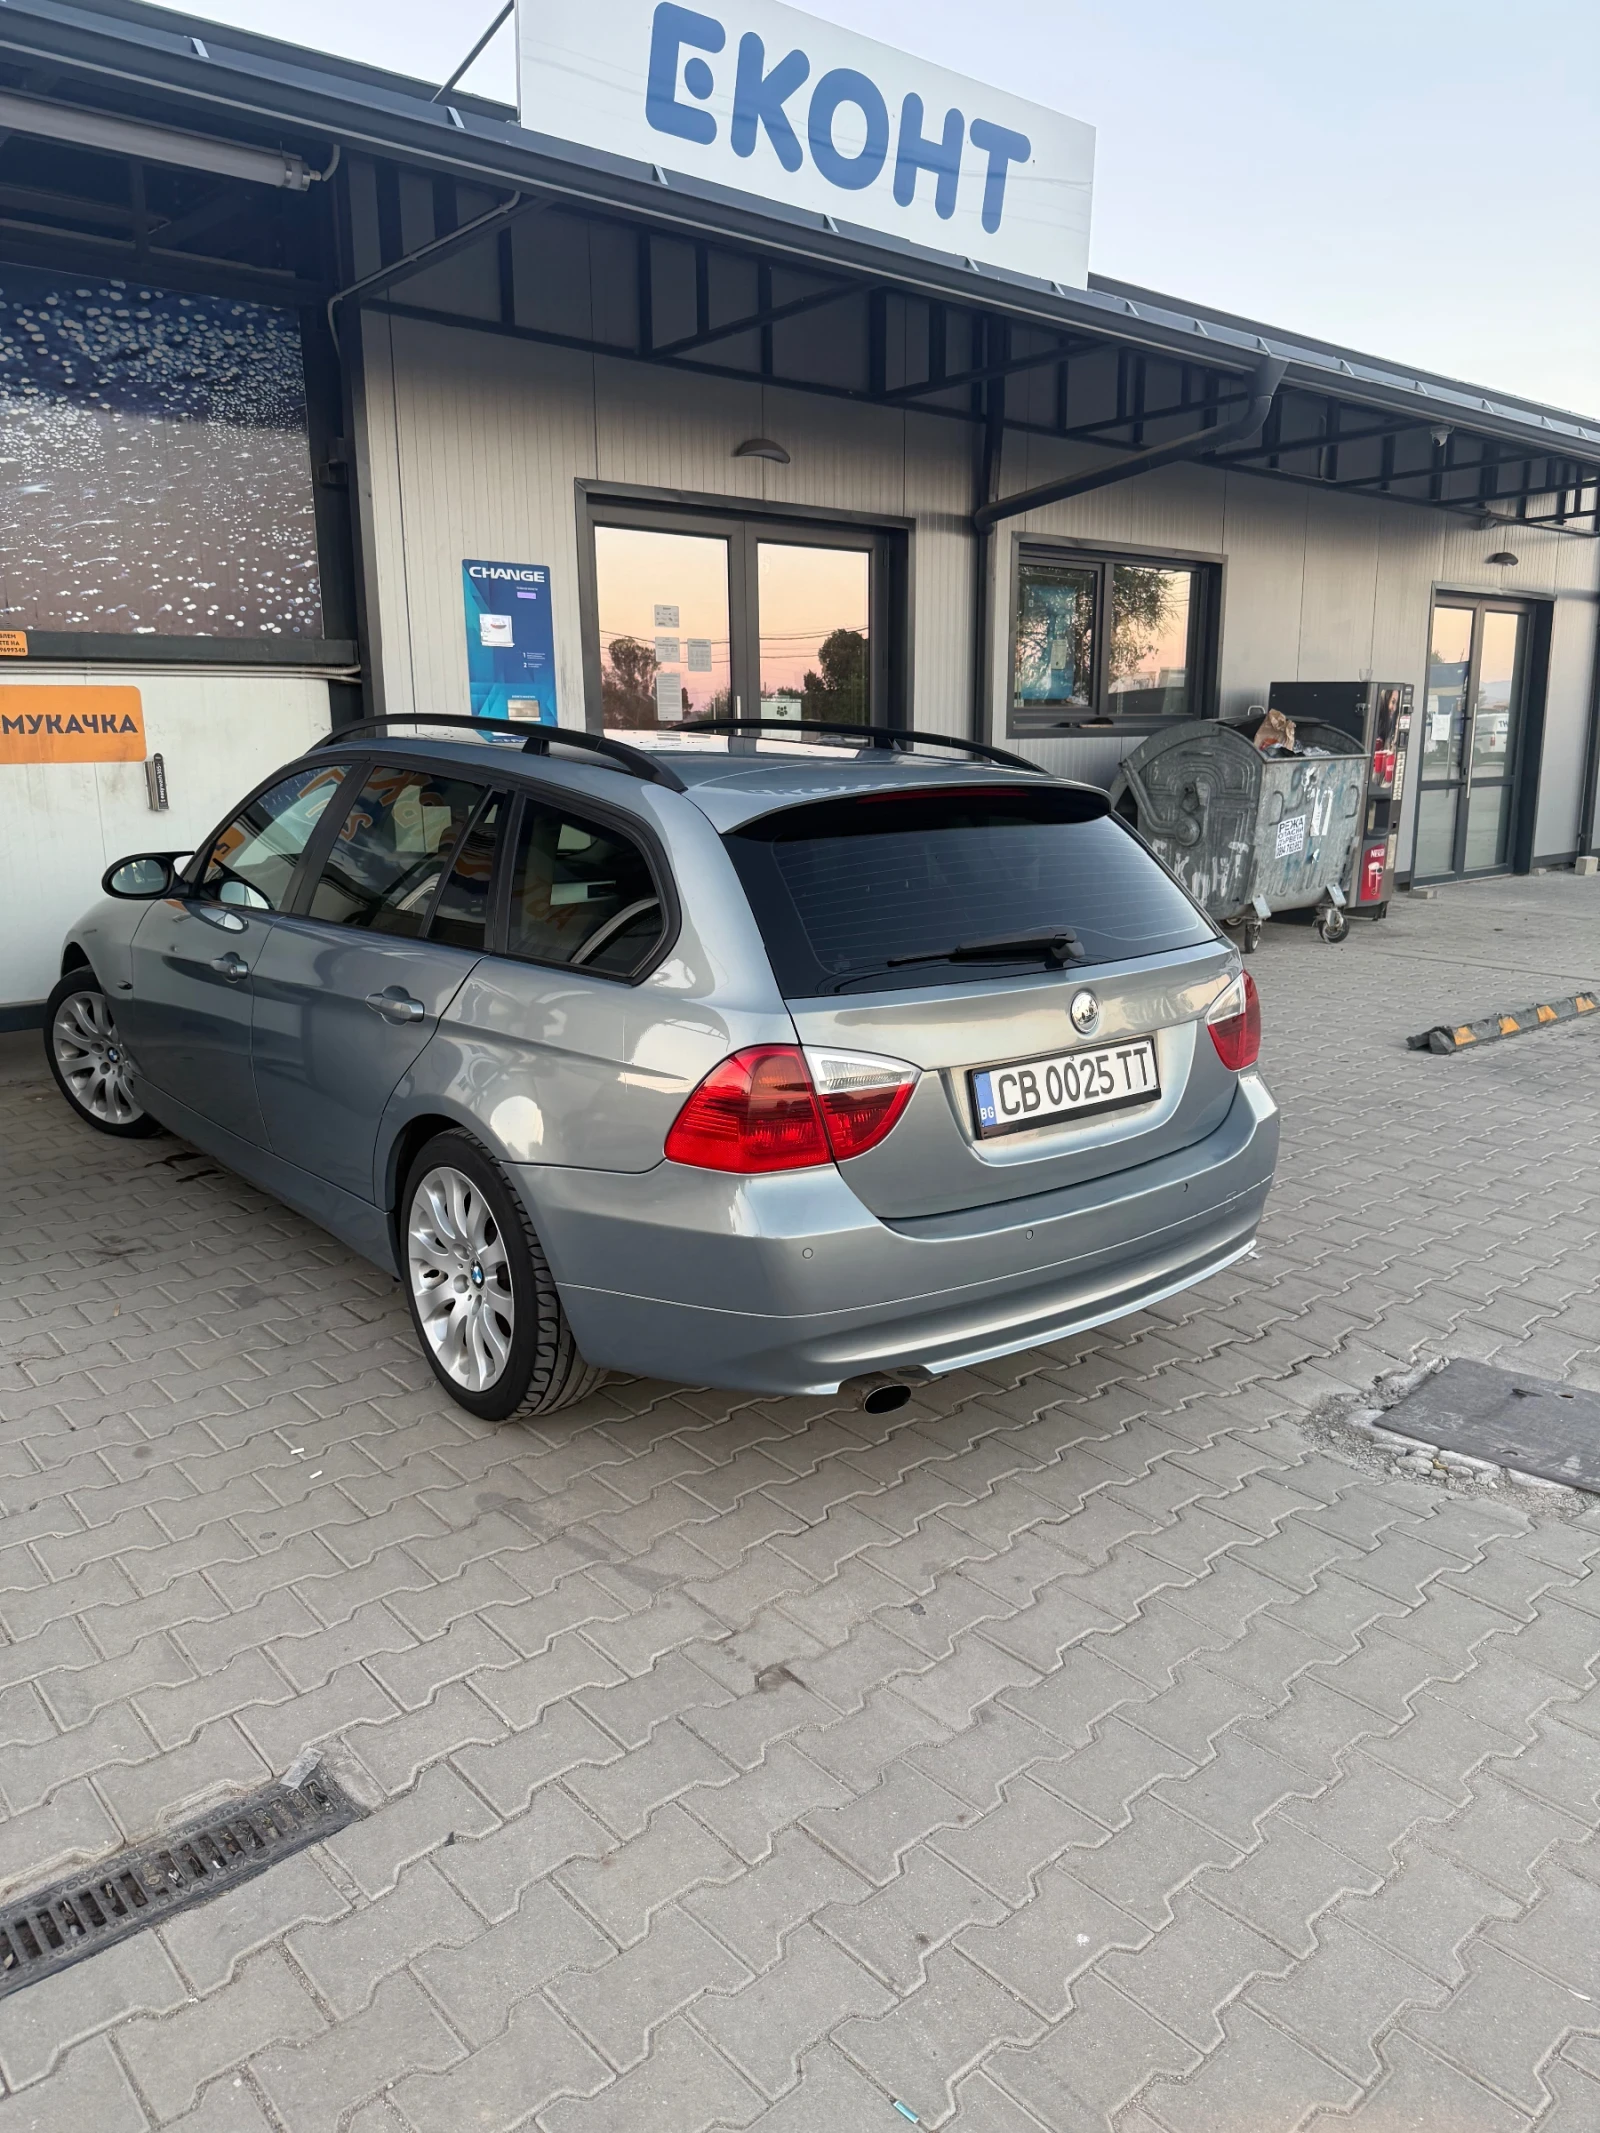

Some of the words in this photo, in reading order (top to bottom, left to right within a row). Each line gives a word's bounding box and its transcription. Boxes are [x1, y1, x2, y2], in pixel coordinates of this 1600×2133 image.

[646, 2, 1031, 234] ЕКОНТ
[468, 566, 545, 583] CHANGE
[1, 714, 138, 734] МУКАЧКА
[1279, 817, 1304, 833] РЕЖА
[1046, 1055, 1114, 1105] 0025
[1116, 1047, 1147, 1089] TT
[980, 1105, 995, 1120] BG
[157, 1858, 249, 1908] VODALAND
